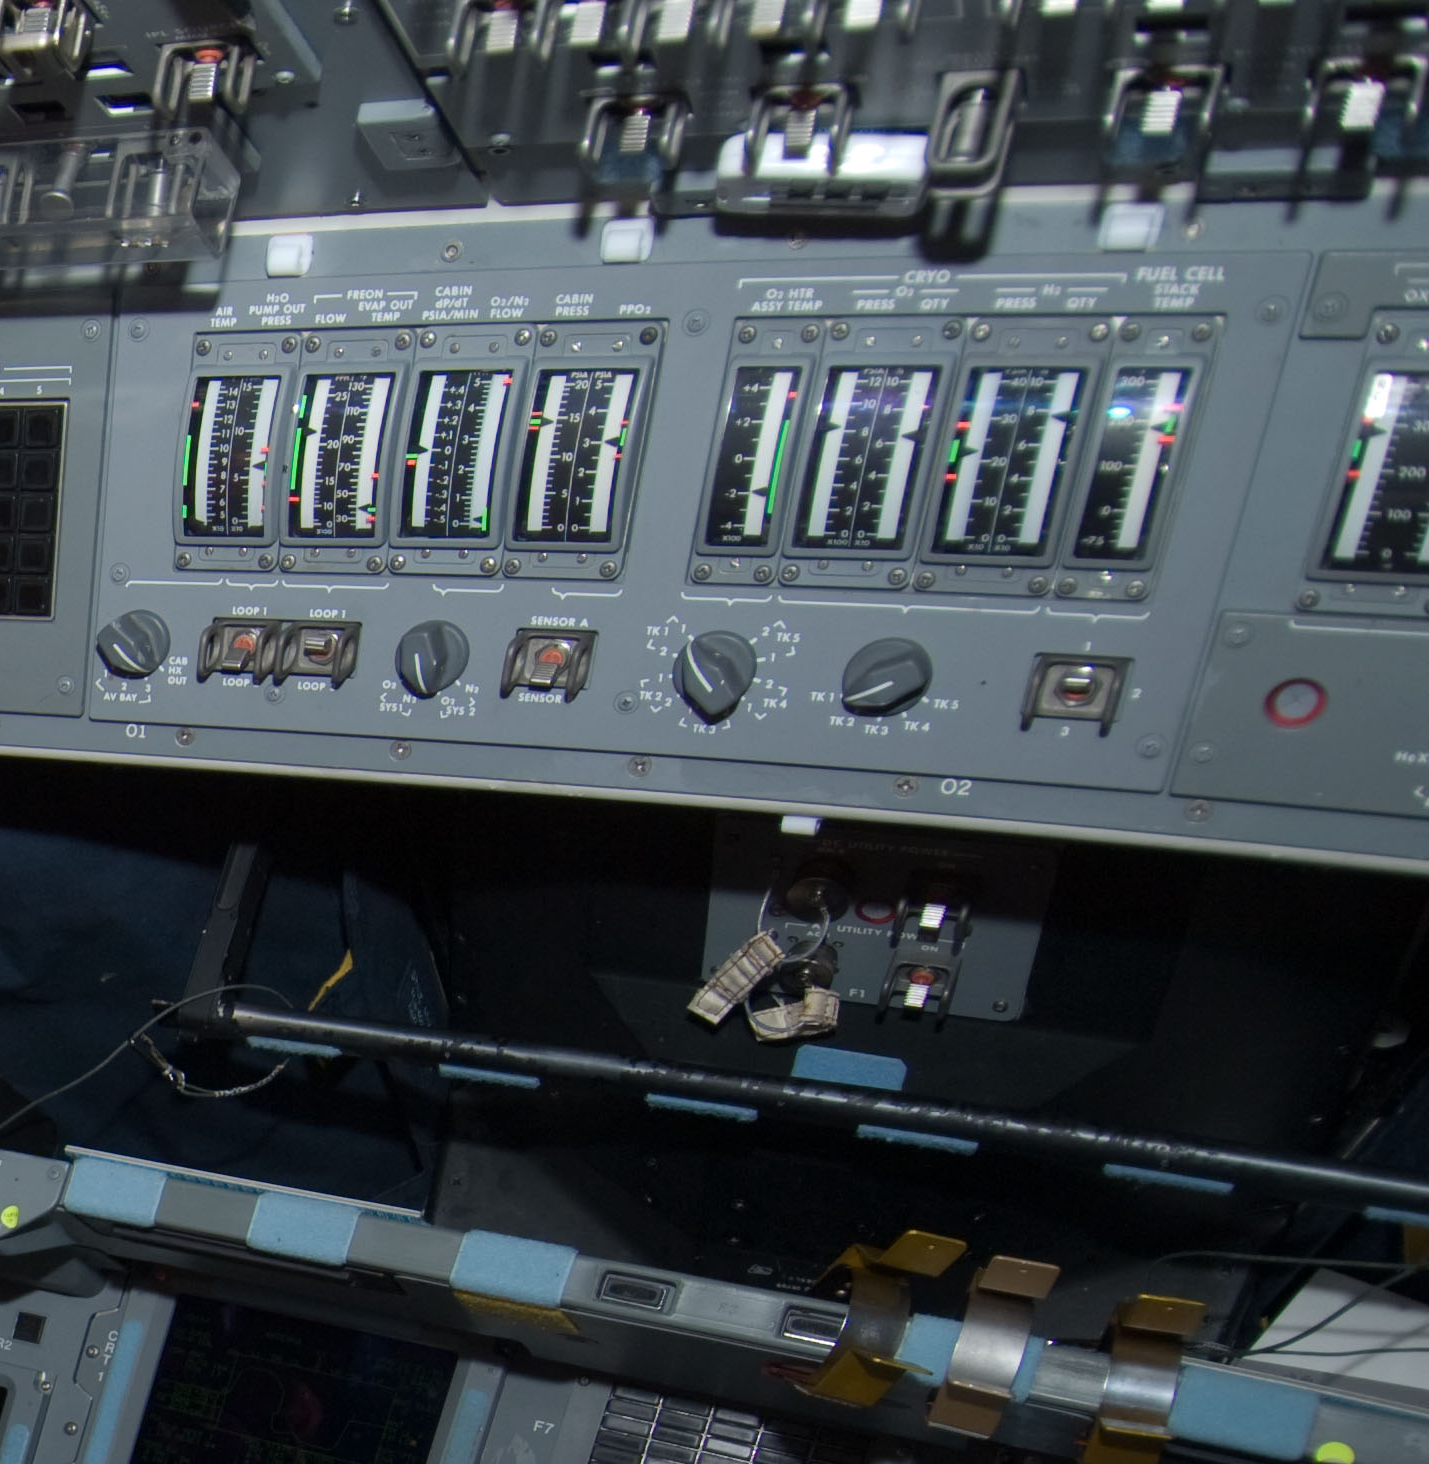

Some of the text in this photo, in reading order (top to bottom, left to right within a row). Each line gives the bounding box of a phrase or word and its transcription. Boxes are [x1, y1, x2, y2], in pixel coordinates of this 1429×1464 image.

[904, 269, 950, 284] CRYO
[1137, 267, 1225, 281] FUEL CELL
[347, 289, 384, 300] FREON
[435, 286, 472, 297] CABIN
[788, 288, 814, 299] HTR
[1155, 283, 1200, 296] STACK
[436, 297, 468, 308] dP/dT
[556, 293, 593, 305] CABIN
[857, 298, 949, 311] PRESS QTY
[996, 296, 1097, 309] PRESS QTY
[1154, 296, 1195, 309] TEMP
[215, 306, 233, 316] AIR
[249, 304, 306, 315] PUMP OUT
[358, 300, 413, 311] EVAP OUT
[555, 305, 589, 316] PRESS
[619, 304, 651, 315] PPO2
[751, 300, 823, 312] ASSY TEMP
[371, 311, 400, 322] TEMP
[422, 308, 479, 320] PSIA/MIN
[490, 308, 523, 318] FLOW
[210, 317, 236, 327] TEMP
[261, 316, 291, 326] PRESS
[315, 314, 347, 324] FLOW
[232, 606, 258, 616] LOOP
[309, 608, 336, 619] LOOP
[530, 616, 574, 627] SENSOR
[169, 656, 188, 665] CAB
[168, 666, 183, 675] HX
[167, 676, 187, 685] OUT
[119, 693, 137, 702] BAY
[517, 692, 563, 704] SENSOR
[837, 925, 882, 937] UTILITY
[921, 944, 938, 953] ON
[849, 989, 865, 998] F1
[533, 1420, 555, 1435] F7
